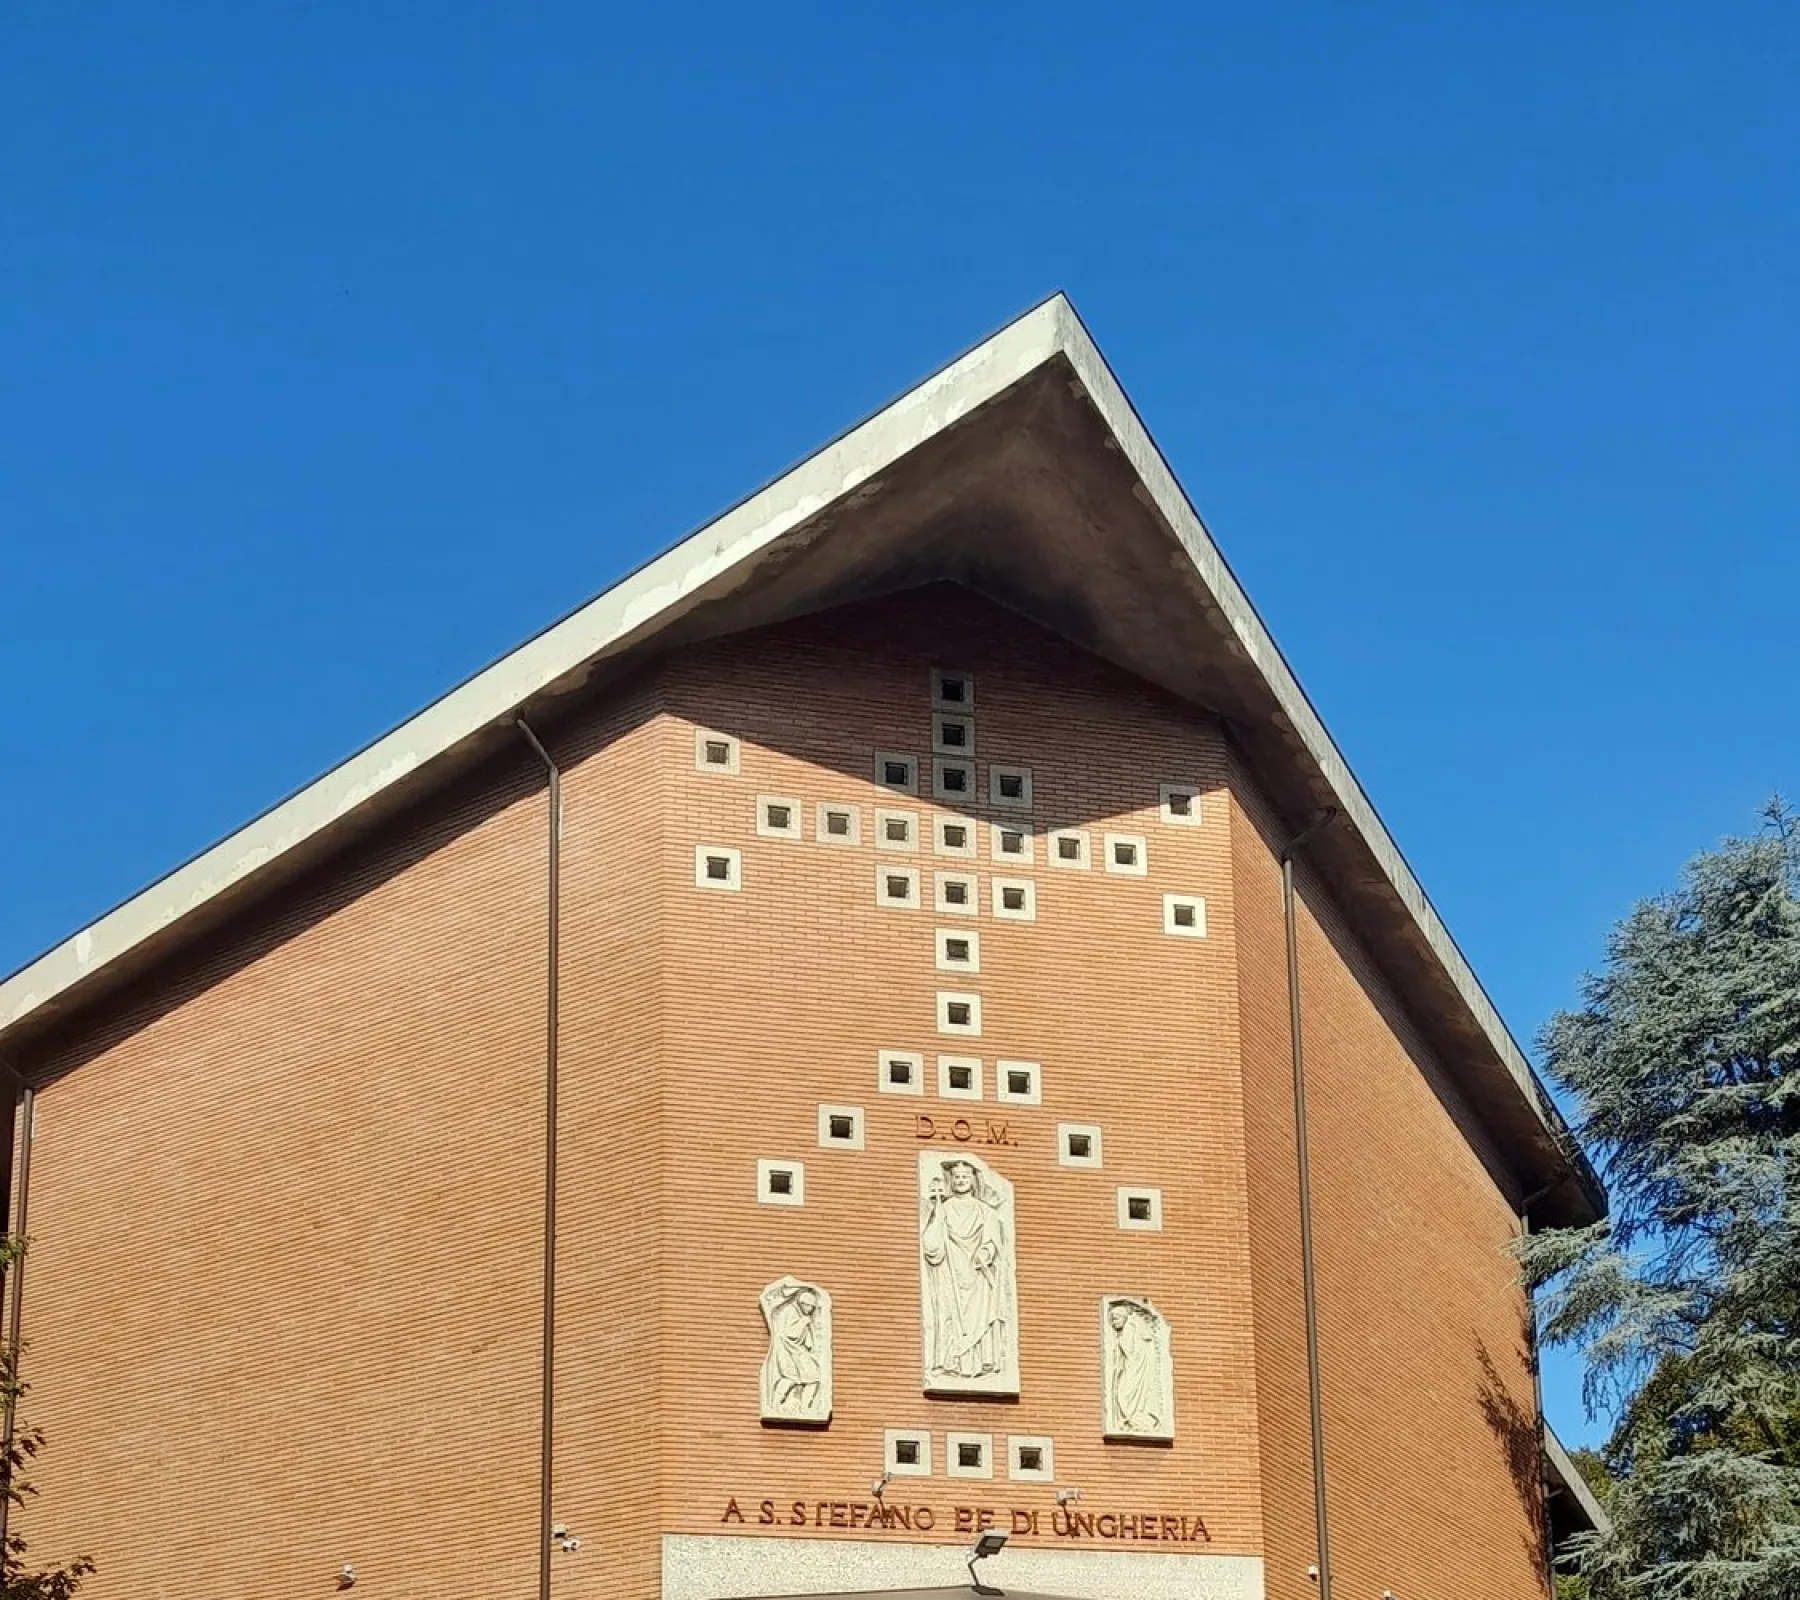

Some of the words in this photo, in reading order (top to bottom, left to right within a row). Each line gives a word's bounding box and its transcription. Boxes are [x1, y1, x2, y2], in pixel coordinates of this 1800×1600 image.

[721, 1496, 745, 1523] A
[759, 1500, 782, 1525] S.
[790, 1501, 935, 1531] STEFANO
[954, 1507, 995, 1534] RE
[1010, 1509, 1039, 1535] DI
[1051, 1511, 1212, 1543] UNGHERIA
